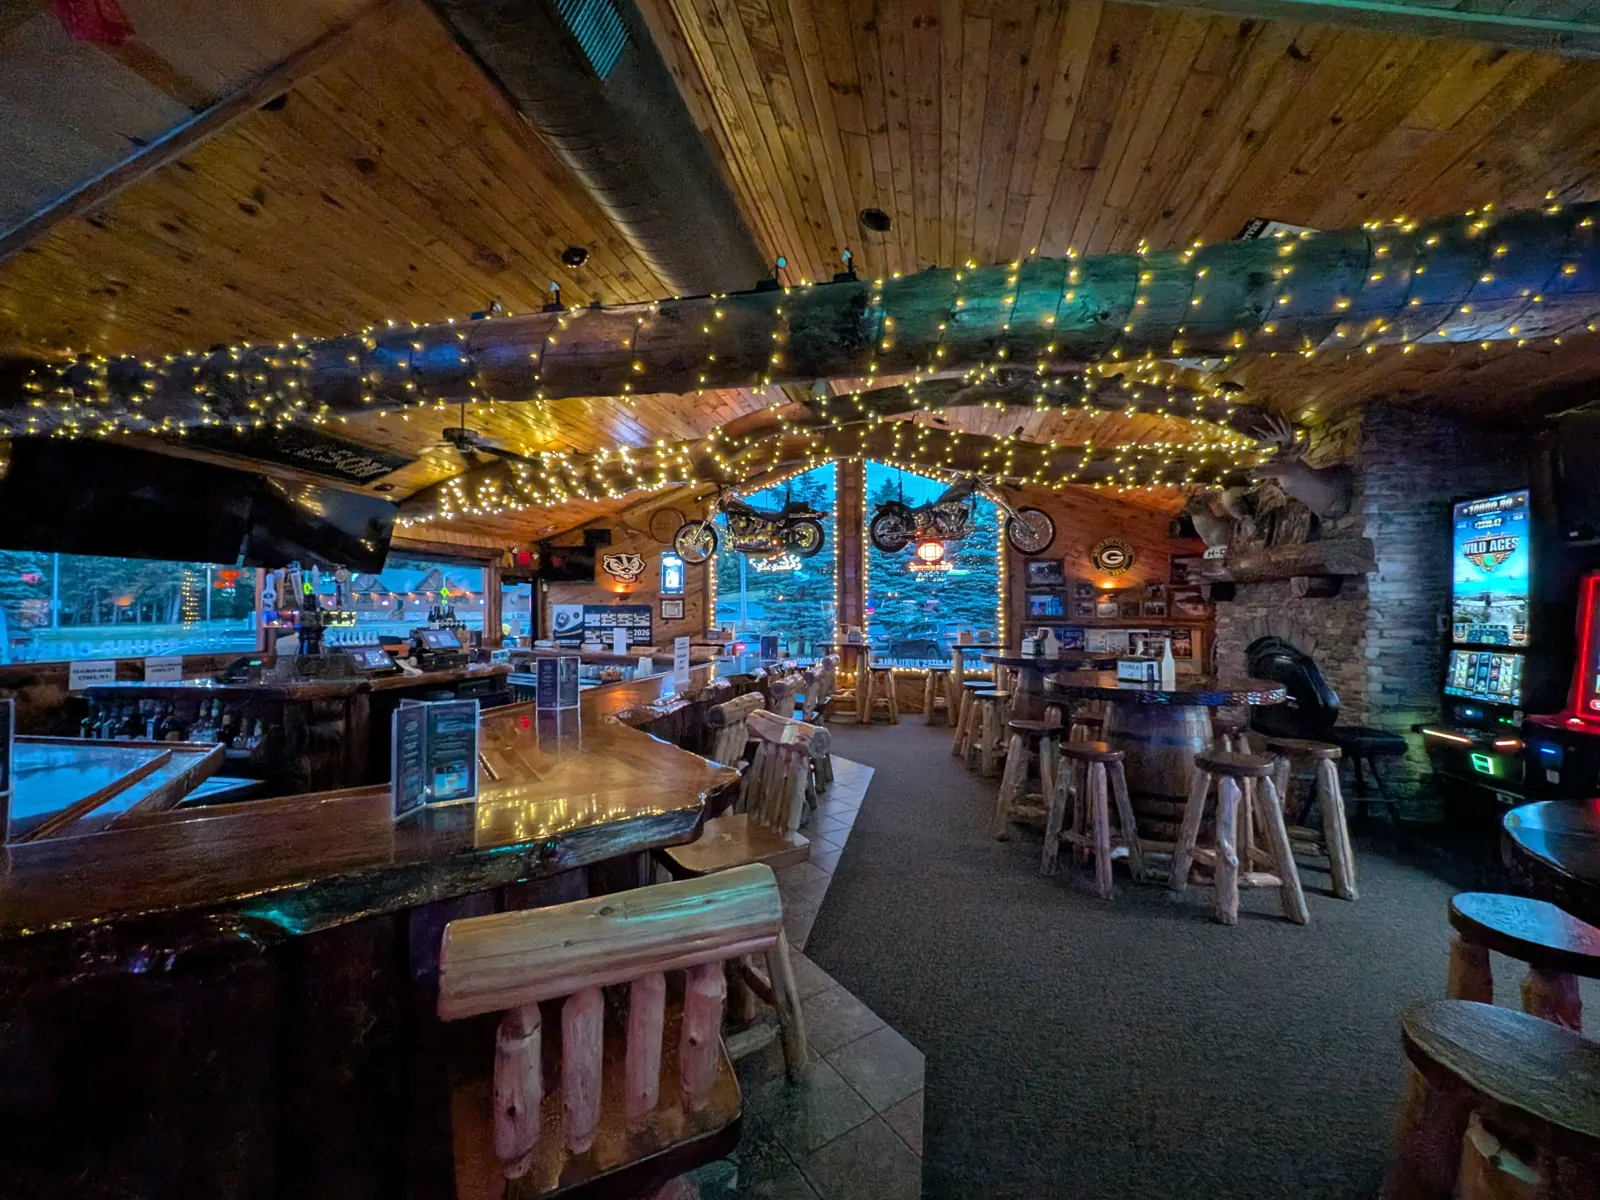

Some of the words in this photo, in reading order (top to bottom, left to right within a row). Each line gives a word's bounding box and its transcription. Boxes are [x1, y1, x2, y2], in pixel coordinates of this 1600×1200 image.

[1462, 542, 1487, 554] WILD
[1489, 538, 1519, 552] ACES
[1101, 550, 1125, 565] G
[633, 629, 650, 637] 2026
